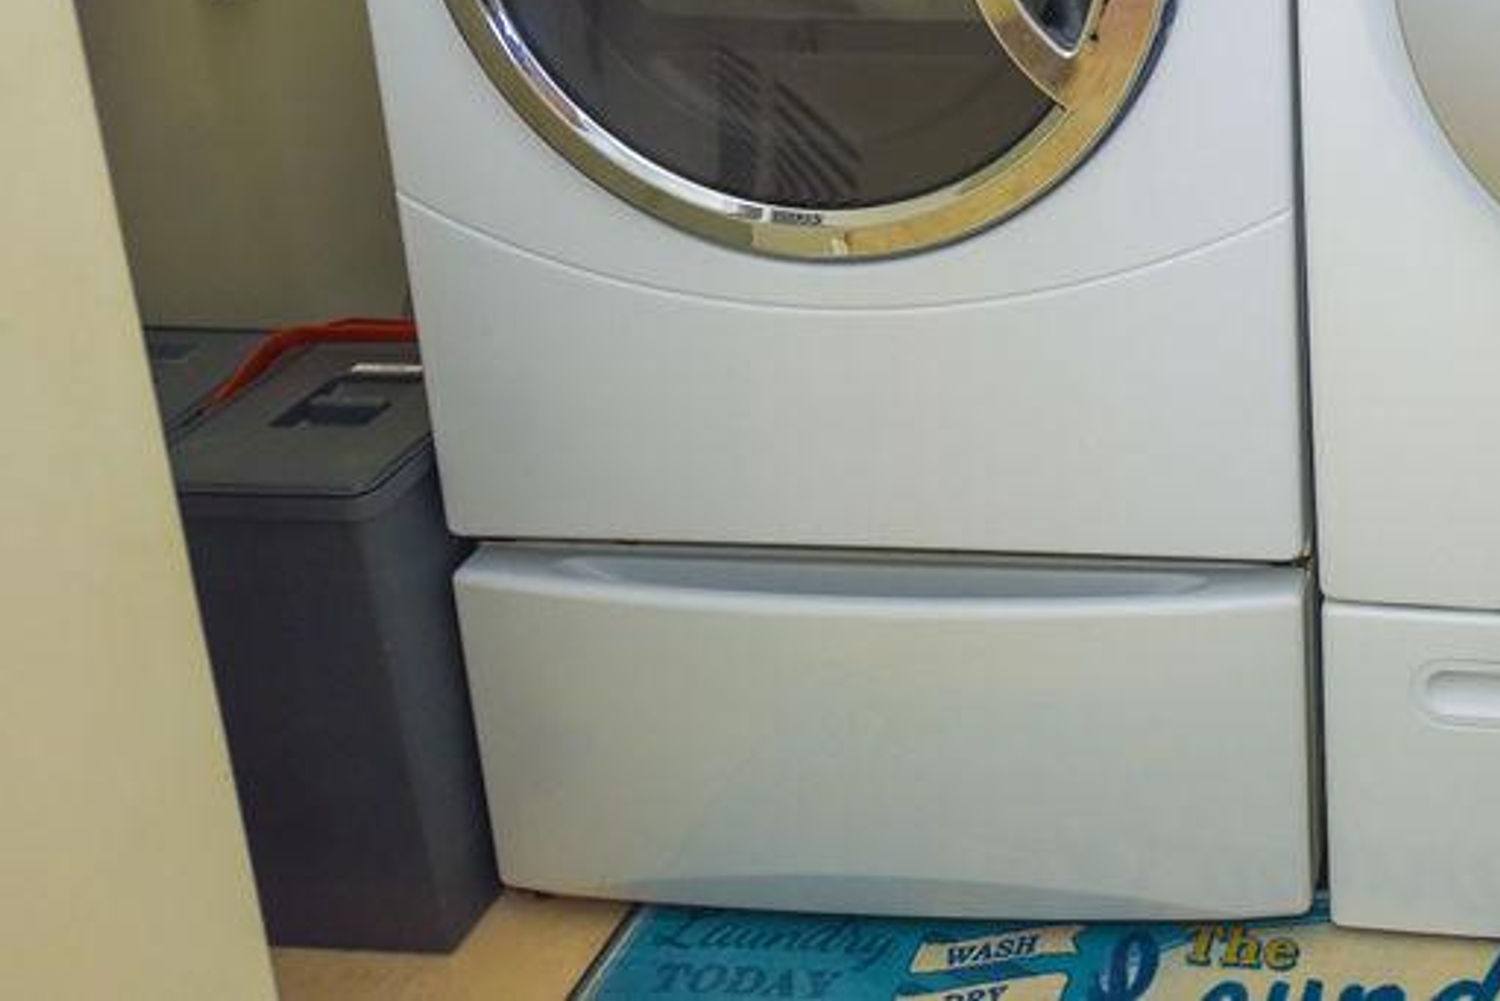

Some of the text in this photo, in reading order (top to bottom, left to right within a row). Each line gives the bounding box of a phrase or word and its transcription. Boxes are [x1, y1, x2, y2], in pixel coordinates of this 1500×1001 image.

[655, 909, 894, 972] Laundry
[946, 934, 1040, 966] WASH
[1185, 924, 1299, 970] The
[653, 963, 843, 997] TODAY
